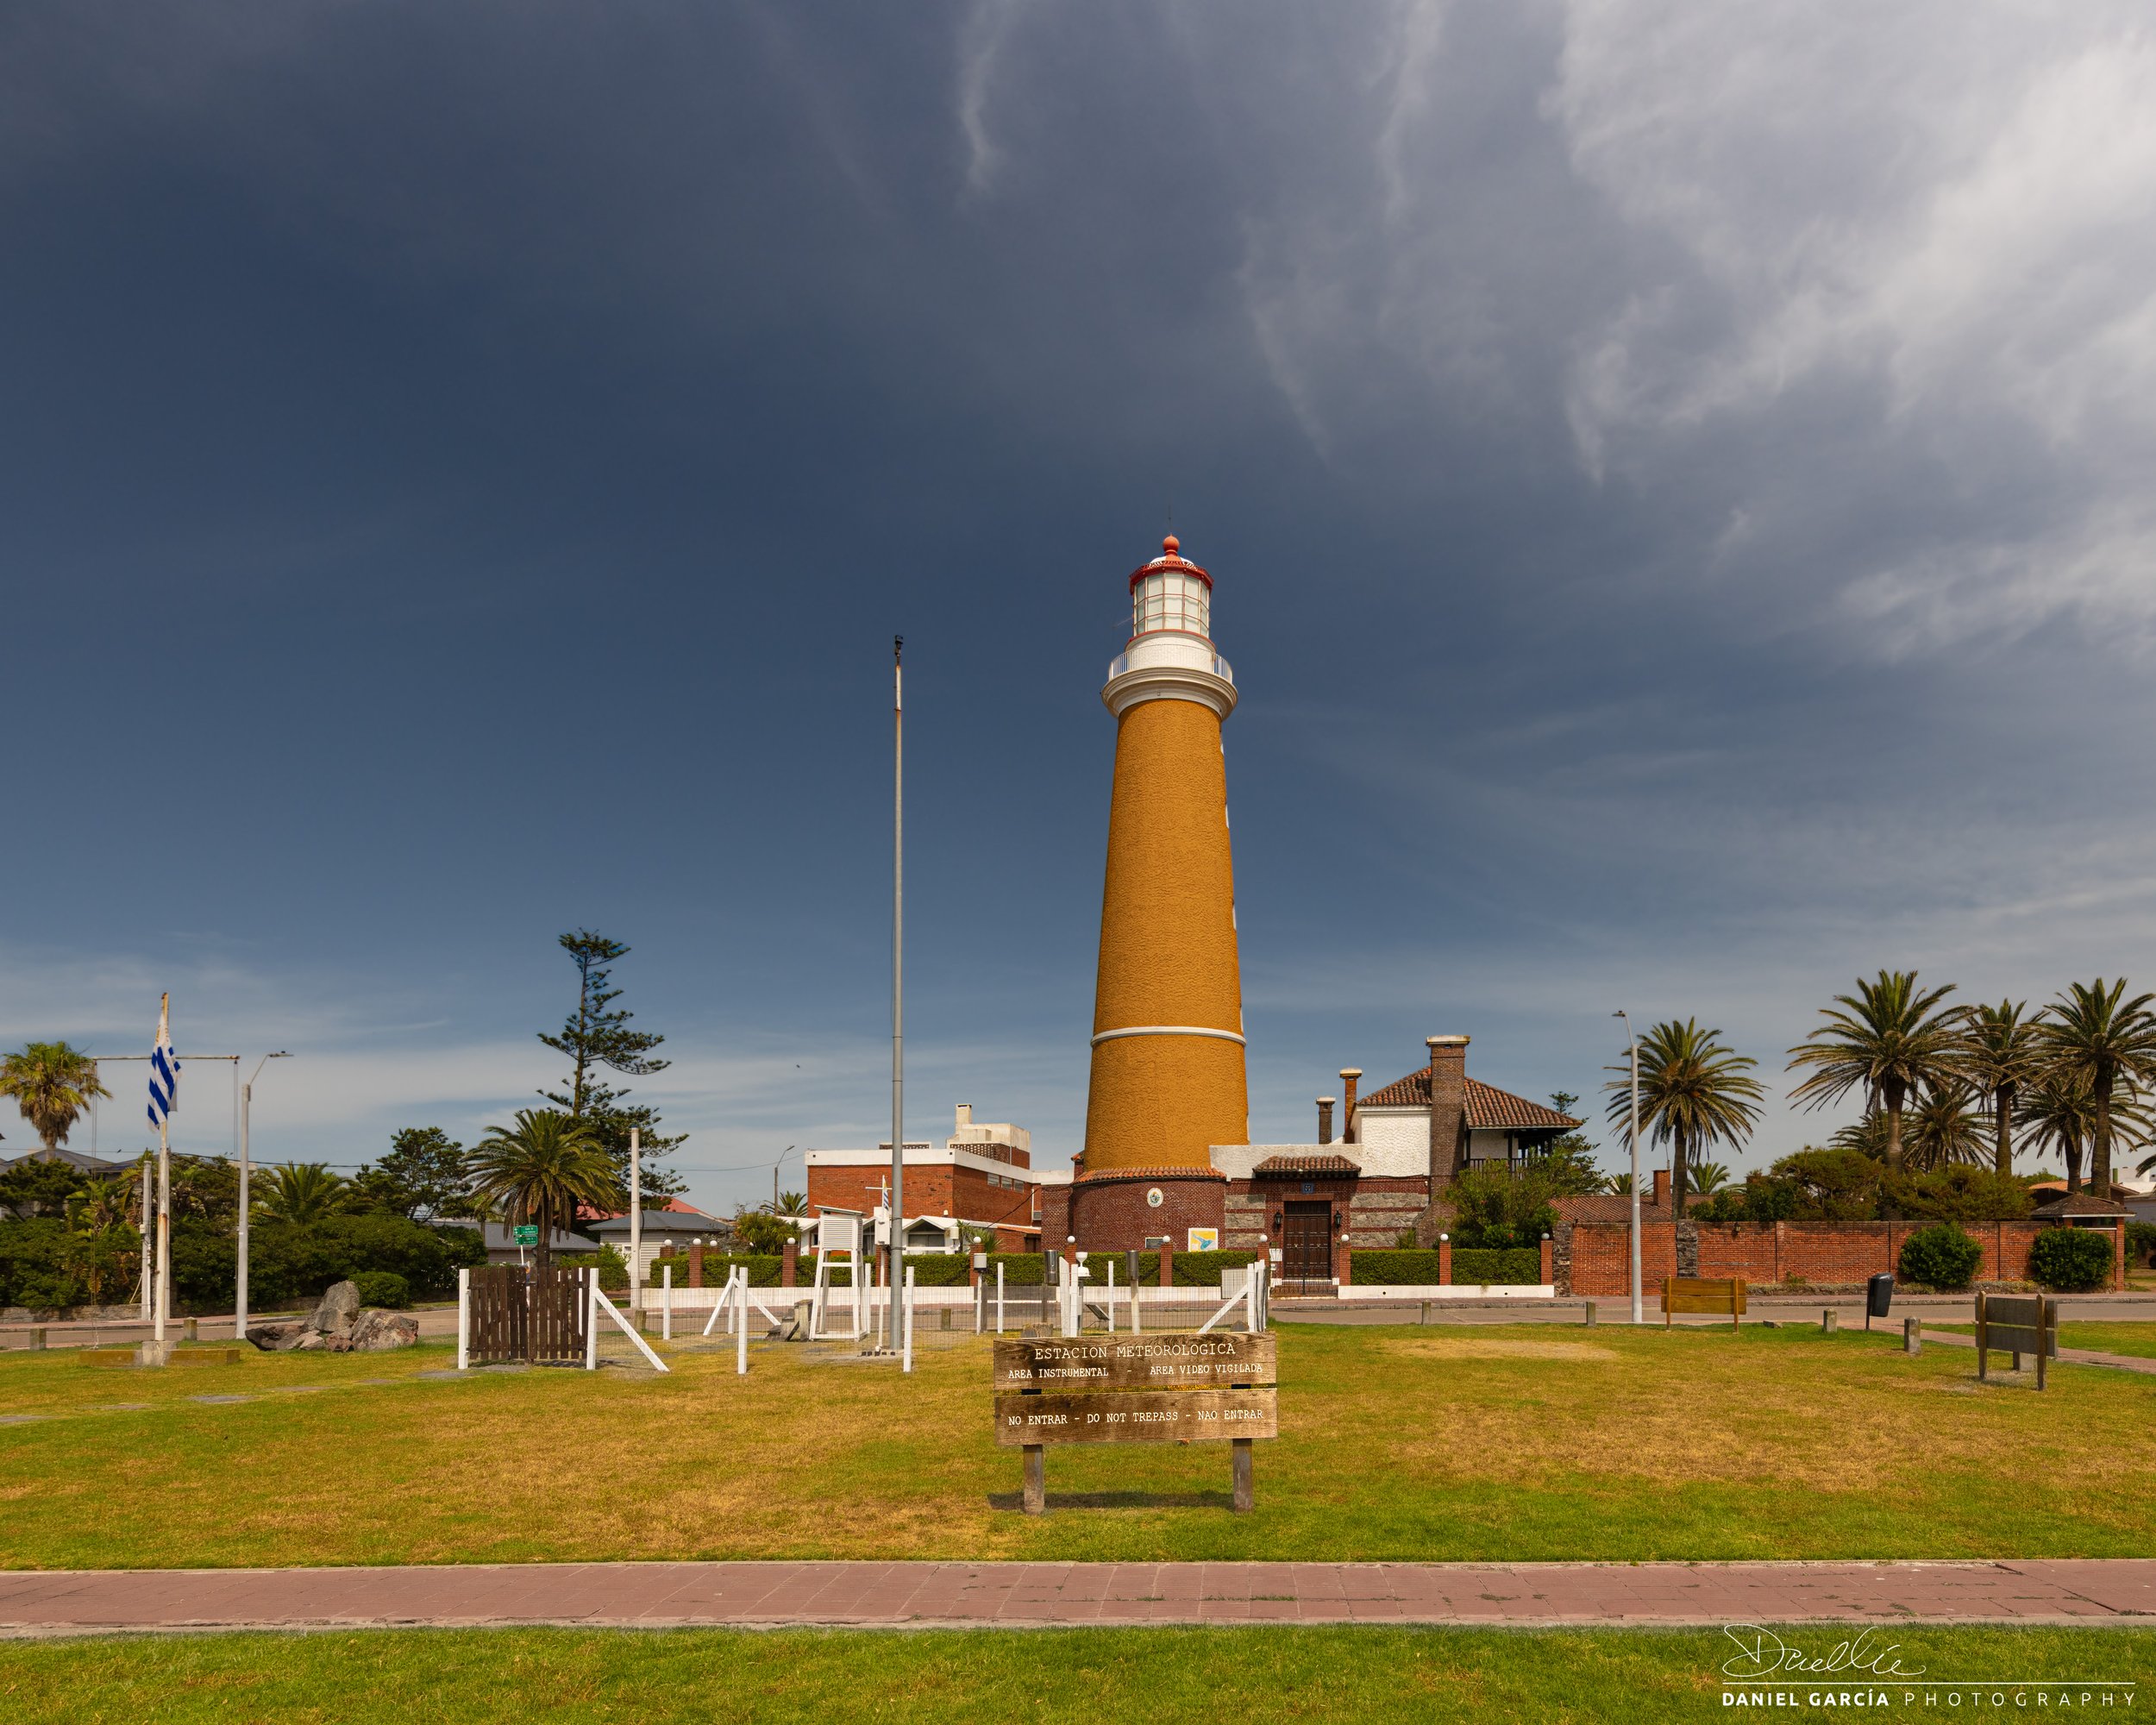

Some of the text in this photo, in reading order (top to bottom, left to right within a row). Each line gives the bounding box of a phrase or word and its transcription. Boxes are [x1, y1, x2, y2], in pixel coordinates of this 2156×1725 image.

[1035, 1343, 1236, 1360] ESTACION METEOROLOGICA
[1007, 1369, 1033, 1379] AREA
[1038, 1367, 1109, 1378] INSTRUMENTAL
[1150, 1365, 1175, 1376] AREA
[1179, 1364, 1210, 1375] VIDEO
[1214, 1363, 1263, 1374] VIGILADA
[1008, 1415, 1021, 1426] NO
[1028, 1414, 1069, 1425] ENTRAR
[1087, 1414, 1100, 1423] DO
[1106, 1413, 1126, 1423] NOT
[1132, 1411, 1179, 1422] TREPASS
[1197, 1410, 1218, 1421] NAO
[1224, 1409, 1264, 1420] ENTRAR
